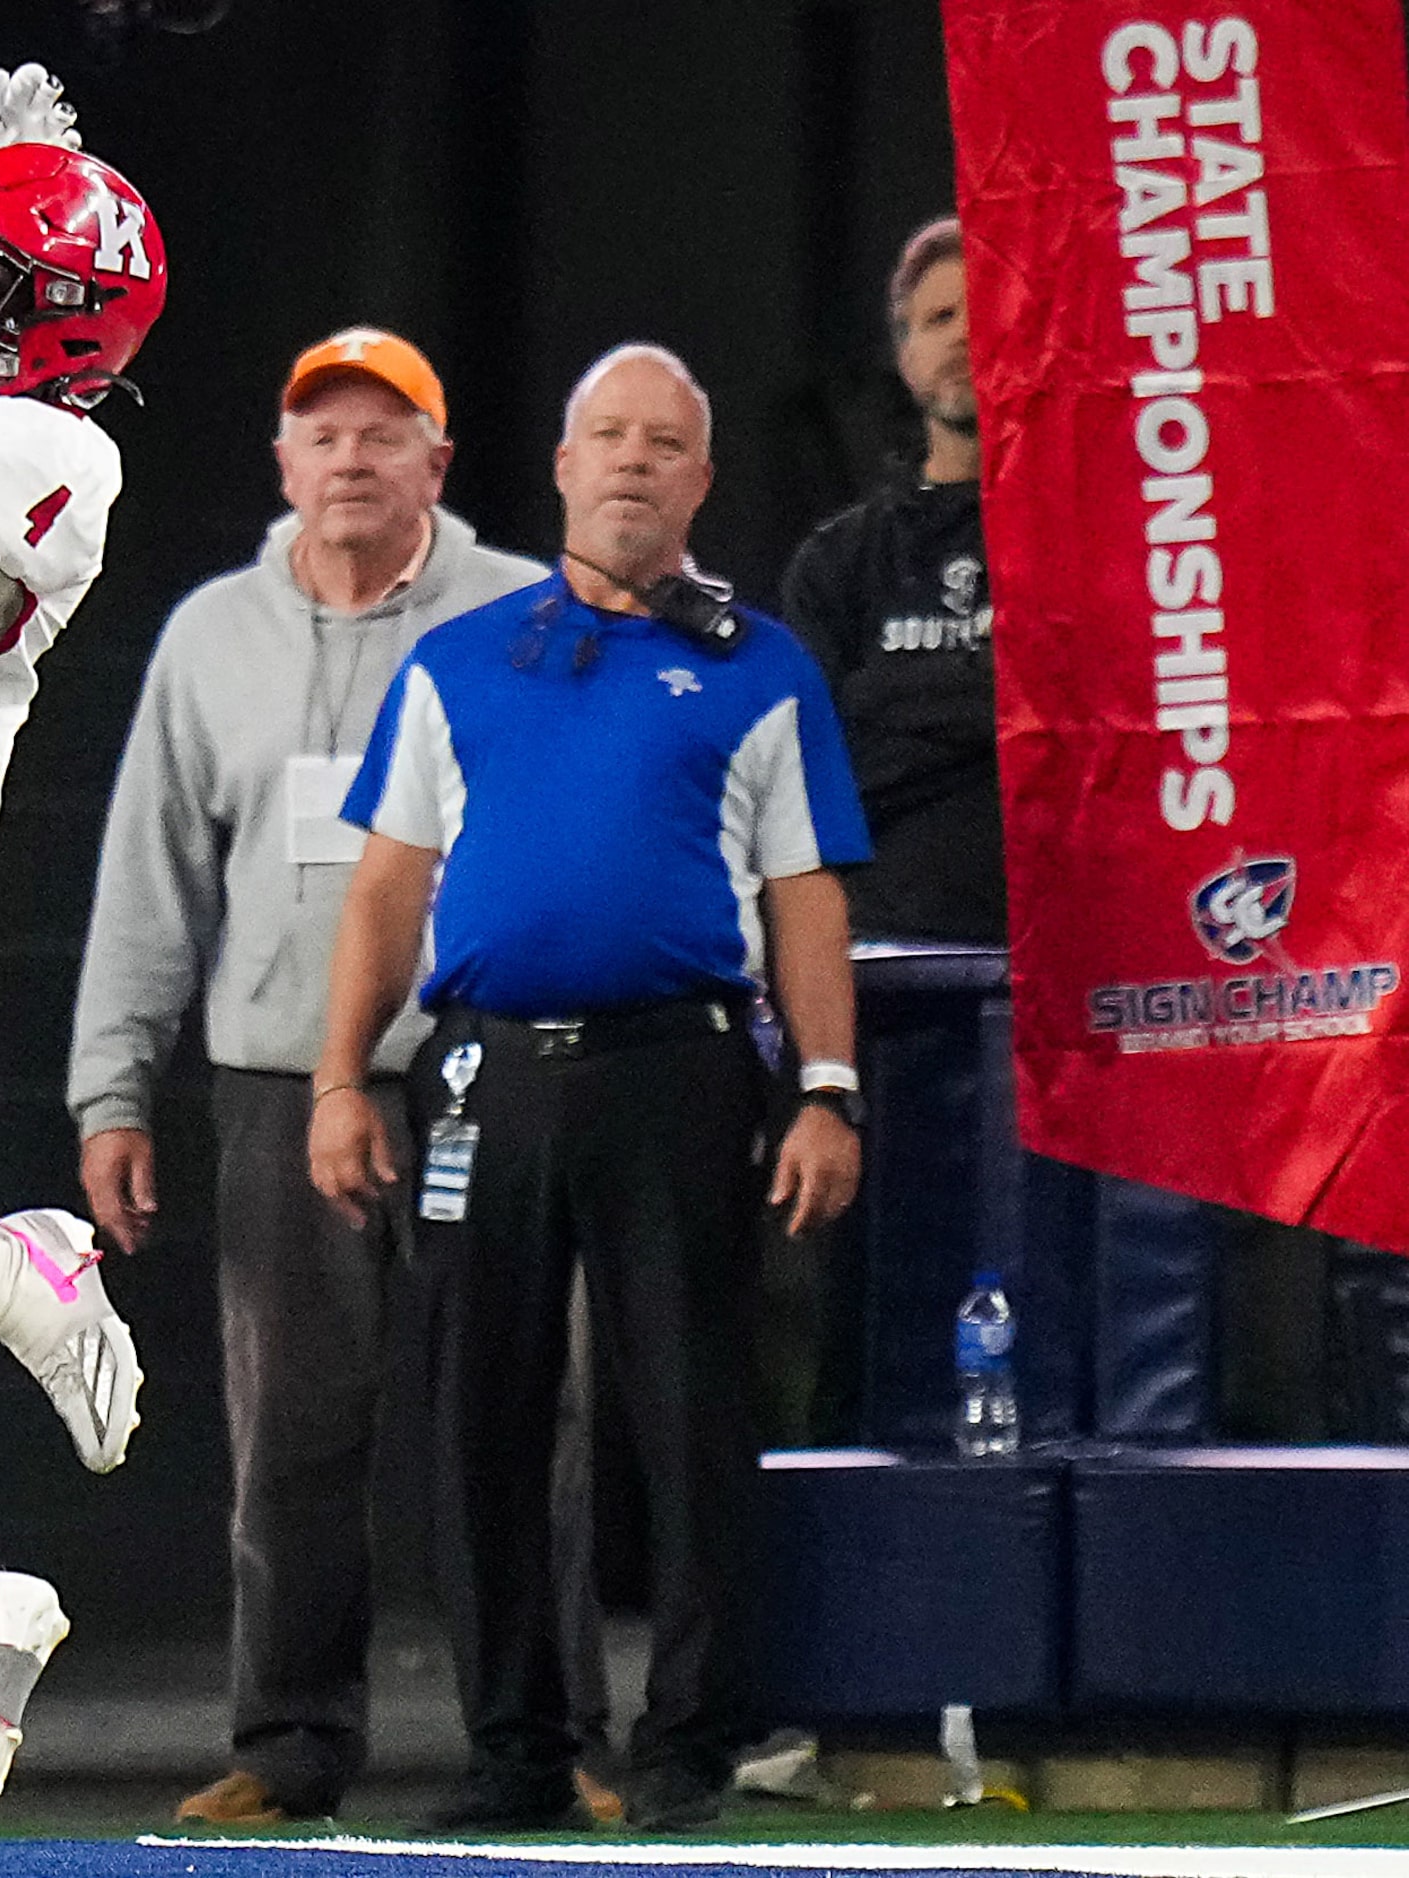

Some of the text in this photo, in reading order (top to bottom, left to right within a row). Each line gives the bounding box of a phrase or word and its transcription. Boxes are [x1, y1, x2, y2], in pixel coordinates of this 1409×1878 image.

[1181, 17, 1274, 323] STATE
[91, 194, 152, 280] K
[332, 329, 386, 362] T
[1100, 20, 1236, 832] CHAMPIONSHIPS
[23, 484, 73, 549] 4
[1091, 965, 1398, 1030] SIGN CHAMP
